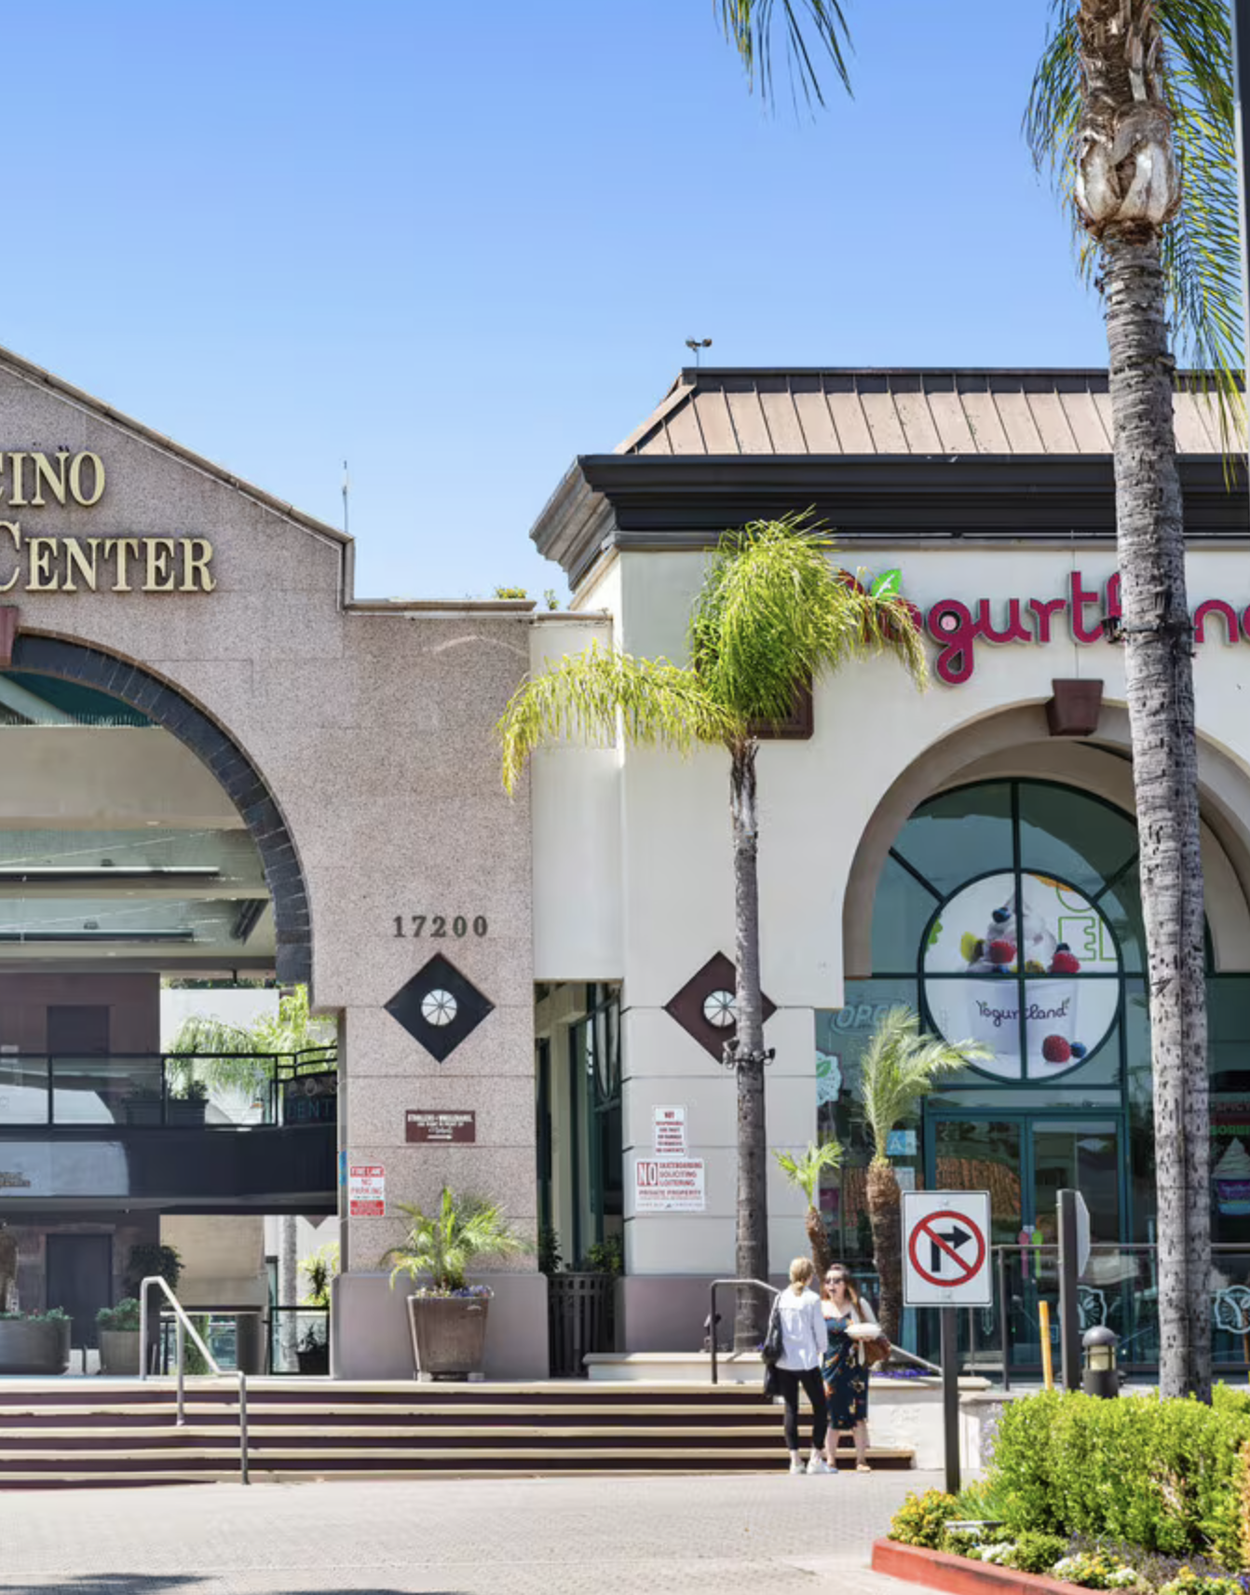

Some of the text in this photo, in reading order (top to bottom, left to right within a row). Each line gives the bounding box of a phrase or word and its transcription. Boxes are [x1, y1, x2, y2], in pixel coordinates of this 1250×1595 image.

[393, 914, 488, 938] 17200
[637, 1162, 658, 1187] NO
[350, 1187, 382, 1195] PARKING
